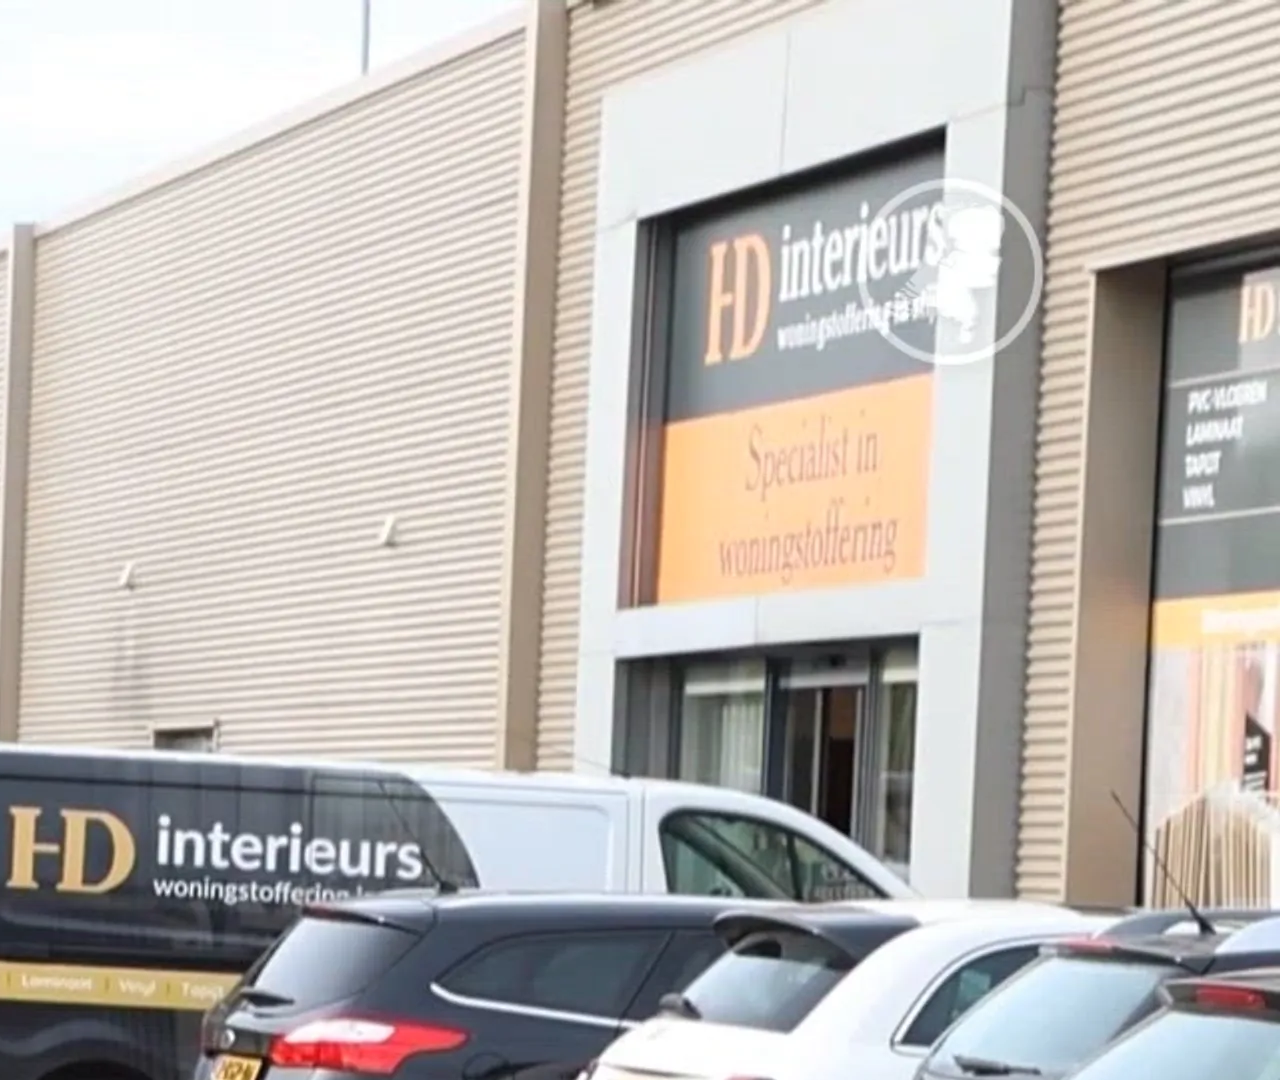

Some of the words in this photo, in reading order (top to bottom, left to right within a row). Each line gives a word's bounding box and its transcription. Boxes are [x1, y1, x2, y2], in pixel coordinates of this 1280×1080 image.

[704, 233, 772, 367] HD
[778, 201, 946, 302] interieurs
[1239, 283, 1275, 344] HD
[744, 415, 847, 503] Specialist
[856, 409, 878, 475] in
[718, 497, 898, 586] woningstoffering
[6, 805, 136, 895] HD
[156, 814, 424, 882] interieurs
[118, 977, 157, 997] Vinyl
